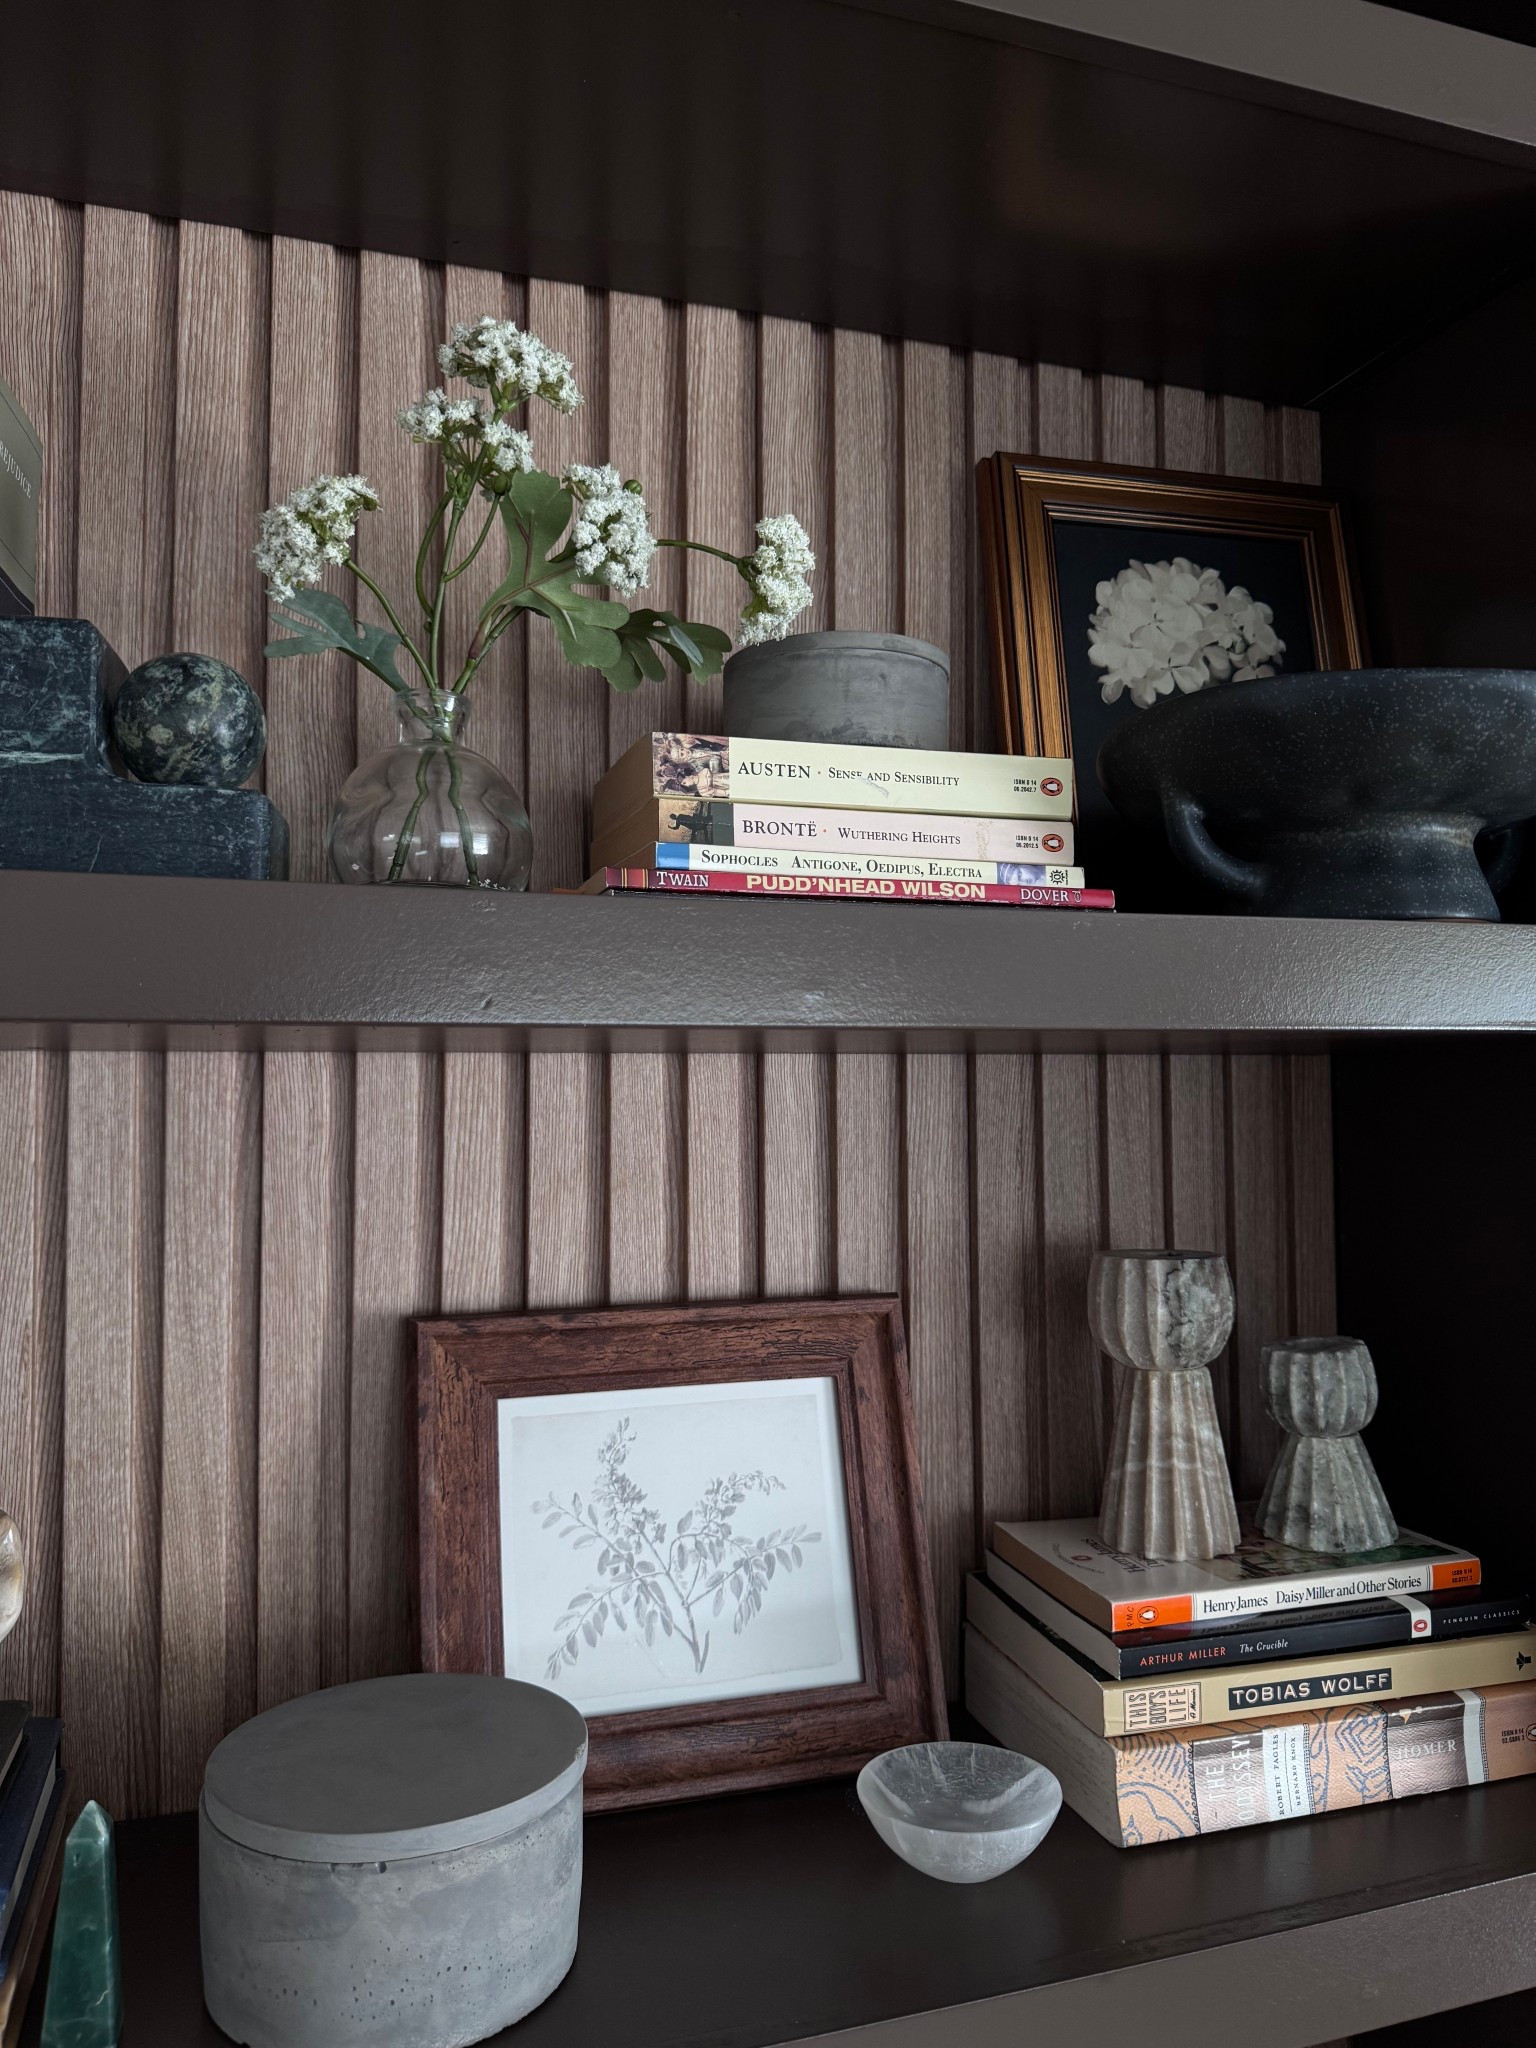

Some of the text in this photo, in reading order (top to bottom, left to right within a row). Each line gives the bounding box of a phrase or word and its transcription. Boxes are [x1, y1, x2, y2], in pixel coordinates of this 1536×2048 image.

[0, 441, 31, 498] REJUDICE
[738, 762, 811, 778] AUSTEN
[867, 772, 891, 782] AND
[894, 771, 960, 786] SENSIBILITY
[742, 820, 961, 844] BRONTË WUTHERING HEIGHTS
[701, 849, 982, 878] SOPHOCLES ANTIGONE, OEDIPUS, ELECTRA
[656, 871, 986, 899] TWAIN PUDD'NHEAD WILSON
[1020, 888, 1069, 902] DOVER
[1203, 1576, 1422, 1613] Henry James Daisy Miller and Other Stories
[1443, 1609, 1520, 1624] PENGUIN CLASSICS
[1140, 1638, 1289, 1667] ARTHUR MILLER The Crucible
[1168, 1688, 1187, 1722] LIFE
[1232, 1673, 1389, 1705] TOBIAS WOLFF
[1128, 1693, 1147, 1728] THIS
[1397, 1739, 1457, 1761] HOMER
[1205, 1763, 1227, 1801] THE
[1232, 1739, 1256, 1822] ODYSSEY
[1272, 1734, 1285, 1816] ROBERT FAGLES
[1292, 1765, 1302, 1806] BERNARD
